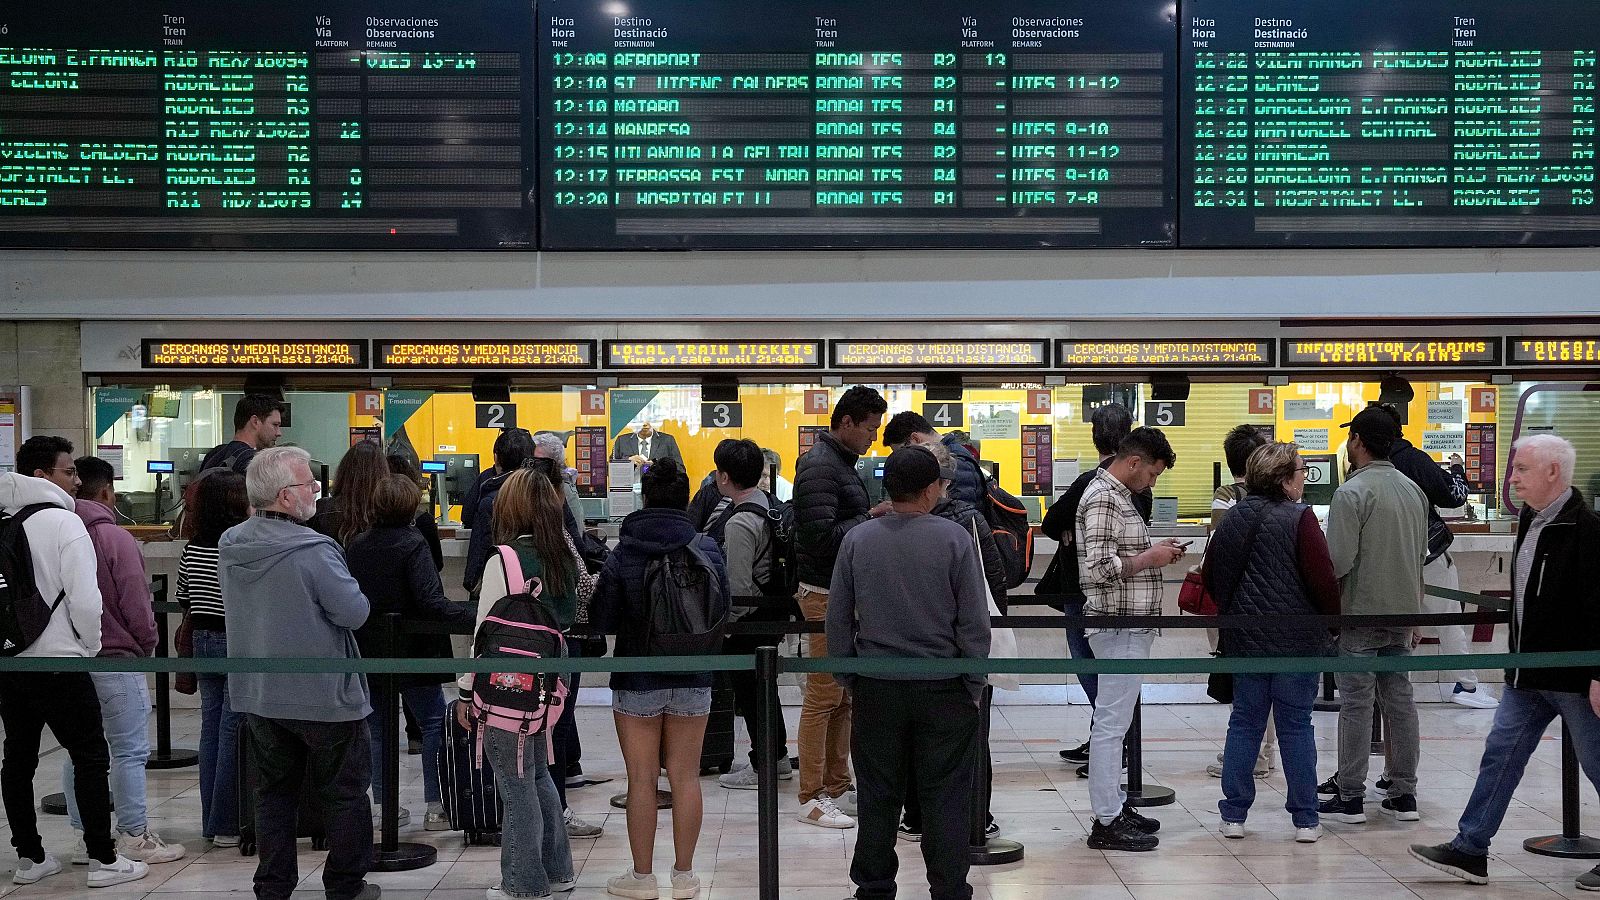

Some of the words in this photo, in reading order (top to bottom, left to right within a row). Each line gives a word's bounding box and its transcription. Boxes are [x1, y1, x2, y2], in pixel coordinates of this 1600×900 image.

[164, 15, 185, 24] Tren
[315, 15, 331, 25] Vía
[366, 16, 439, 26] Observaciones
[551, 16, 574, 26] Hora
[614, 17, 652, 26] Destino
[815, 16, 836, 26] Tren
[962, 16, 977, 26] Vía
[1012, 16, 1084, 27] Observaciones
[1192, 17, 1215, 27] Hora
[1254, 17, 1292, 27] Destino
[1453, 16, 1475, 26] Tren
[163, 27, 186, 36] Tren
[315, 28, 332, 37] Via
[366, 28, 435, 38] Observacions
[551, 28, 575, 38] Hora
[614, 28, 668, 38] Destinació
[815, 28, 838, 38] Tren
[961, 28, 978, 38] Via
[1012, 28, 1080, 38] Observacions
[1192, 29, 1216, 38] Hora
[1254, 28, 1308, 39] Destinació
[1453, 28, 1477, 38] Tren
[233, 344, 240, 355] Y
[244, 344, 281, 355] MEDIA
[284, 344, 349, 355] DISTANCIA
[463, 344, 470, 355] Y
[475, 344, 511, 355] MEDIA
[514, 344, 579, 355] DISTANCIA
[612, 345, 666, 355] LOCAL
[676, 345, 729, 355] TRAIN
[739, 345, 813, 355] TICKETS
[918, 344, 925, 355] Y
[929, 344, 963, 355] MEDIA
[966, 344, 1032, 355] DISTANCIA
[1296, 342, 1404, 353] INFORMATION
[1427, 342, 1486, 353] CLAIMS
[1522, 341, 1596, 352] TANCAT
[154, 354, 209, 364] Horario
[212, 354, 228, 364] de
[231, 354, 270, 364] venta
[273, 354, 312, 364] hasta
[315, 354, 355, 364] 21:40h
[386, 355, 440, 364] Horario
[442, 355, 459, 364] de
[462, 355, 500, 364] venta
[504, 355, 541, 364] hasta
[544, 355, 584, 364] 21:40h
[622, 355, 655, 364] Time
[661, 355, 676, 364] of
[681, 355, 712, 364] sale
[717, 355, 752, 364] until
[842, 355, 893, 364] Horario
[897, 355, 913, 364] de
[917, 355, 954, 364] venta
[958, 355, 994, 364] hasta
[1320, 352, 1378, 363] LOCAL
[1390, 352, 1462, 363] TRAINS
[366, 394, 381, 409] R
[590, 394, 605, 410] R
[813, 394, 828, 409] R
[1036, 393, 1051, 409] R
[1258, 392, 1273, 408] R
[1481, 392, 1495, 407] R
[487, 404, 506, 427] 2
[713, 404, 731, 427] 3
[933, 404, 952, 427] 4
[1155, 403, 1174, 426] 5
